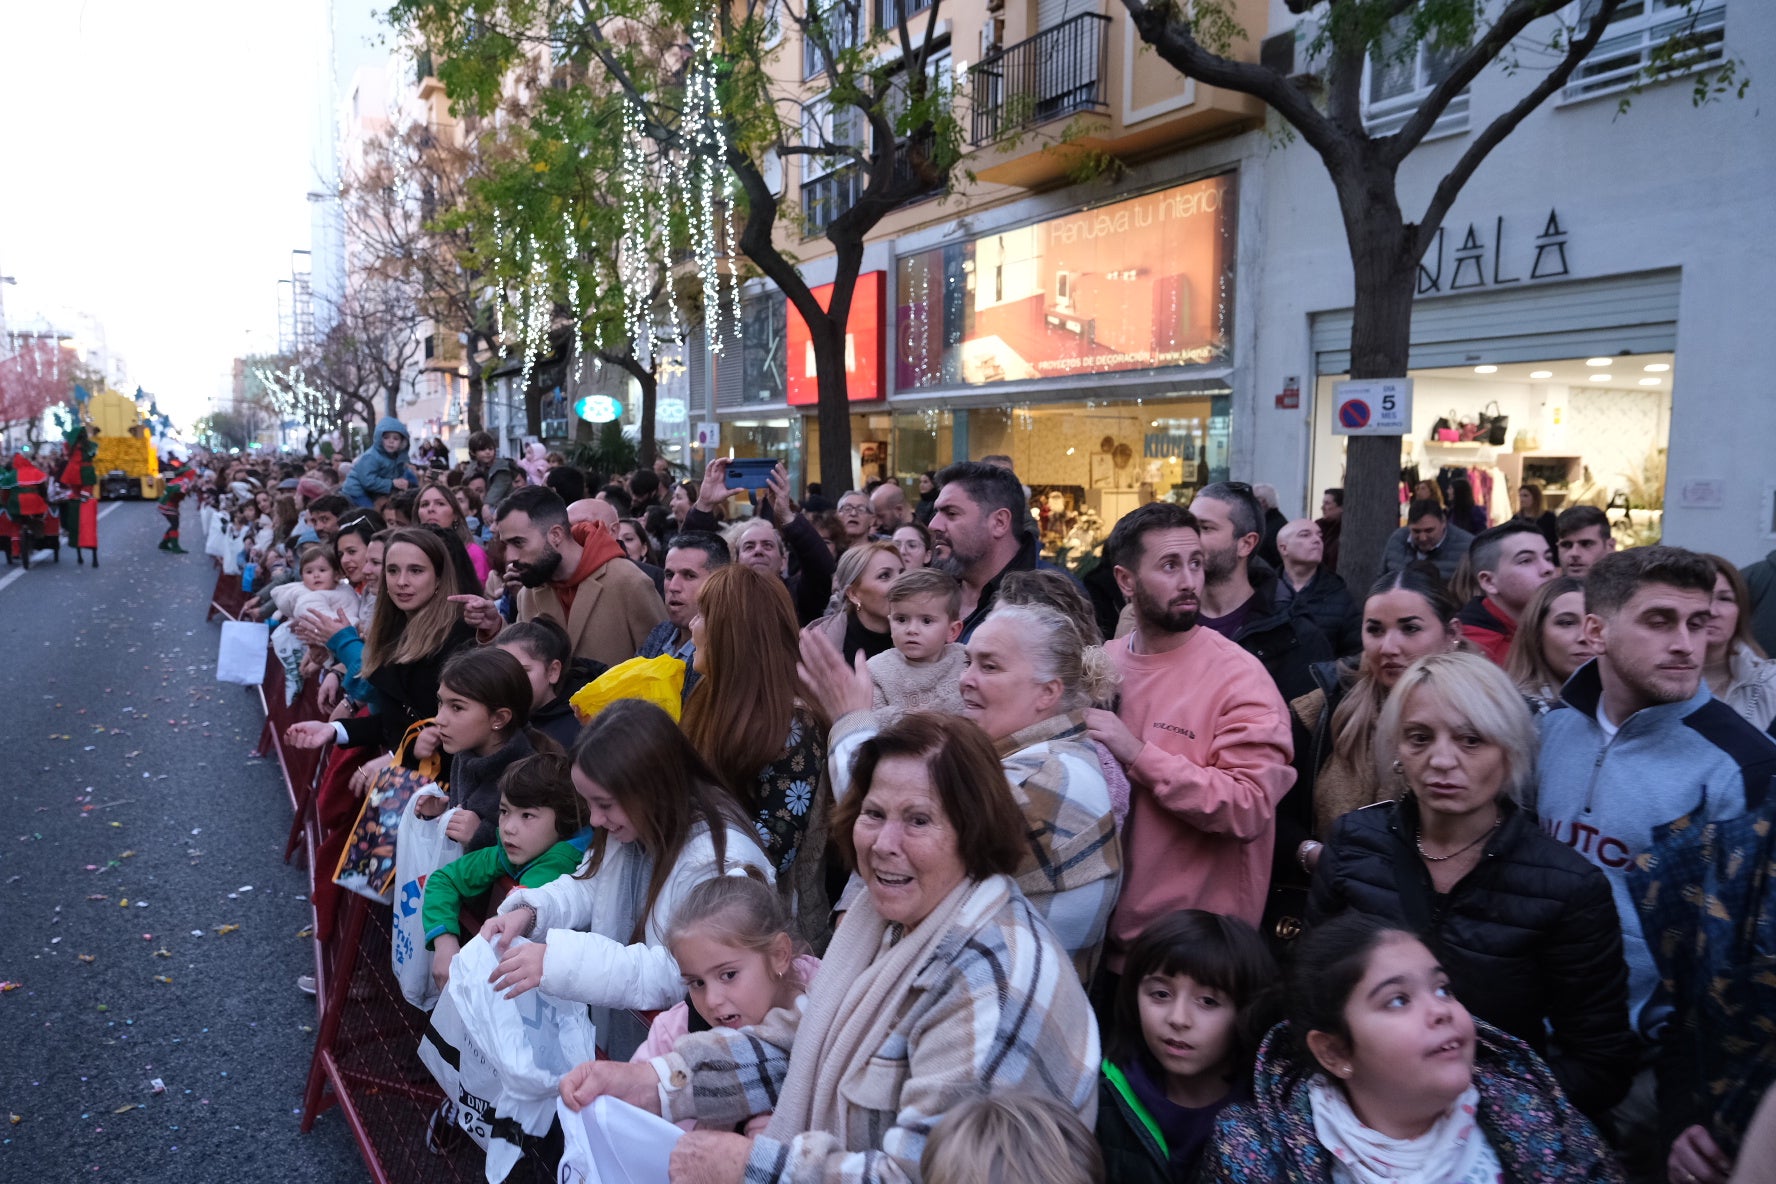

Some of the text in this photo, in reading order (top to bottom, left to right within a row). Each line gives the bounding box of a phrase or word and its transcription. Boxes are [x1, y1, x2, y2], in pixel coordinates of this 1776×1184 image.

[1134, 202, 1153, 228] tu
[1158, 185, 1228, 221] interior
[1038, 357, 1081, 369] PROYECTOS
[1083, 356, 1094, 367] DE
[1382, 395, 1396, 411] 5
